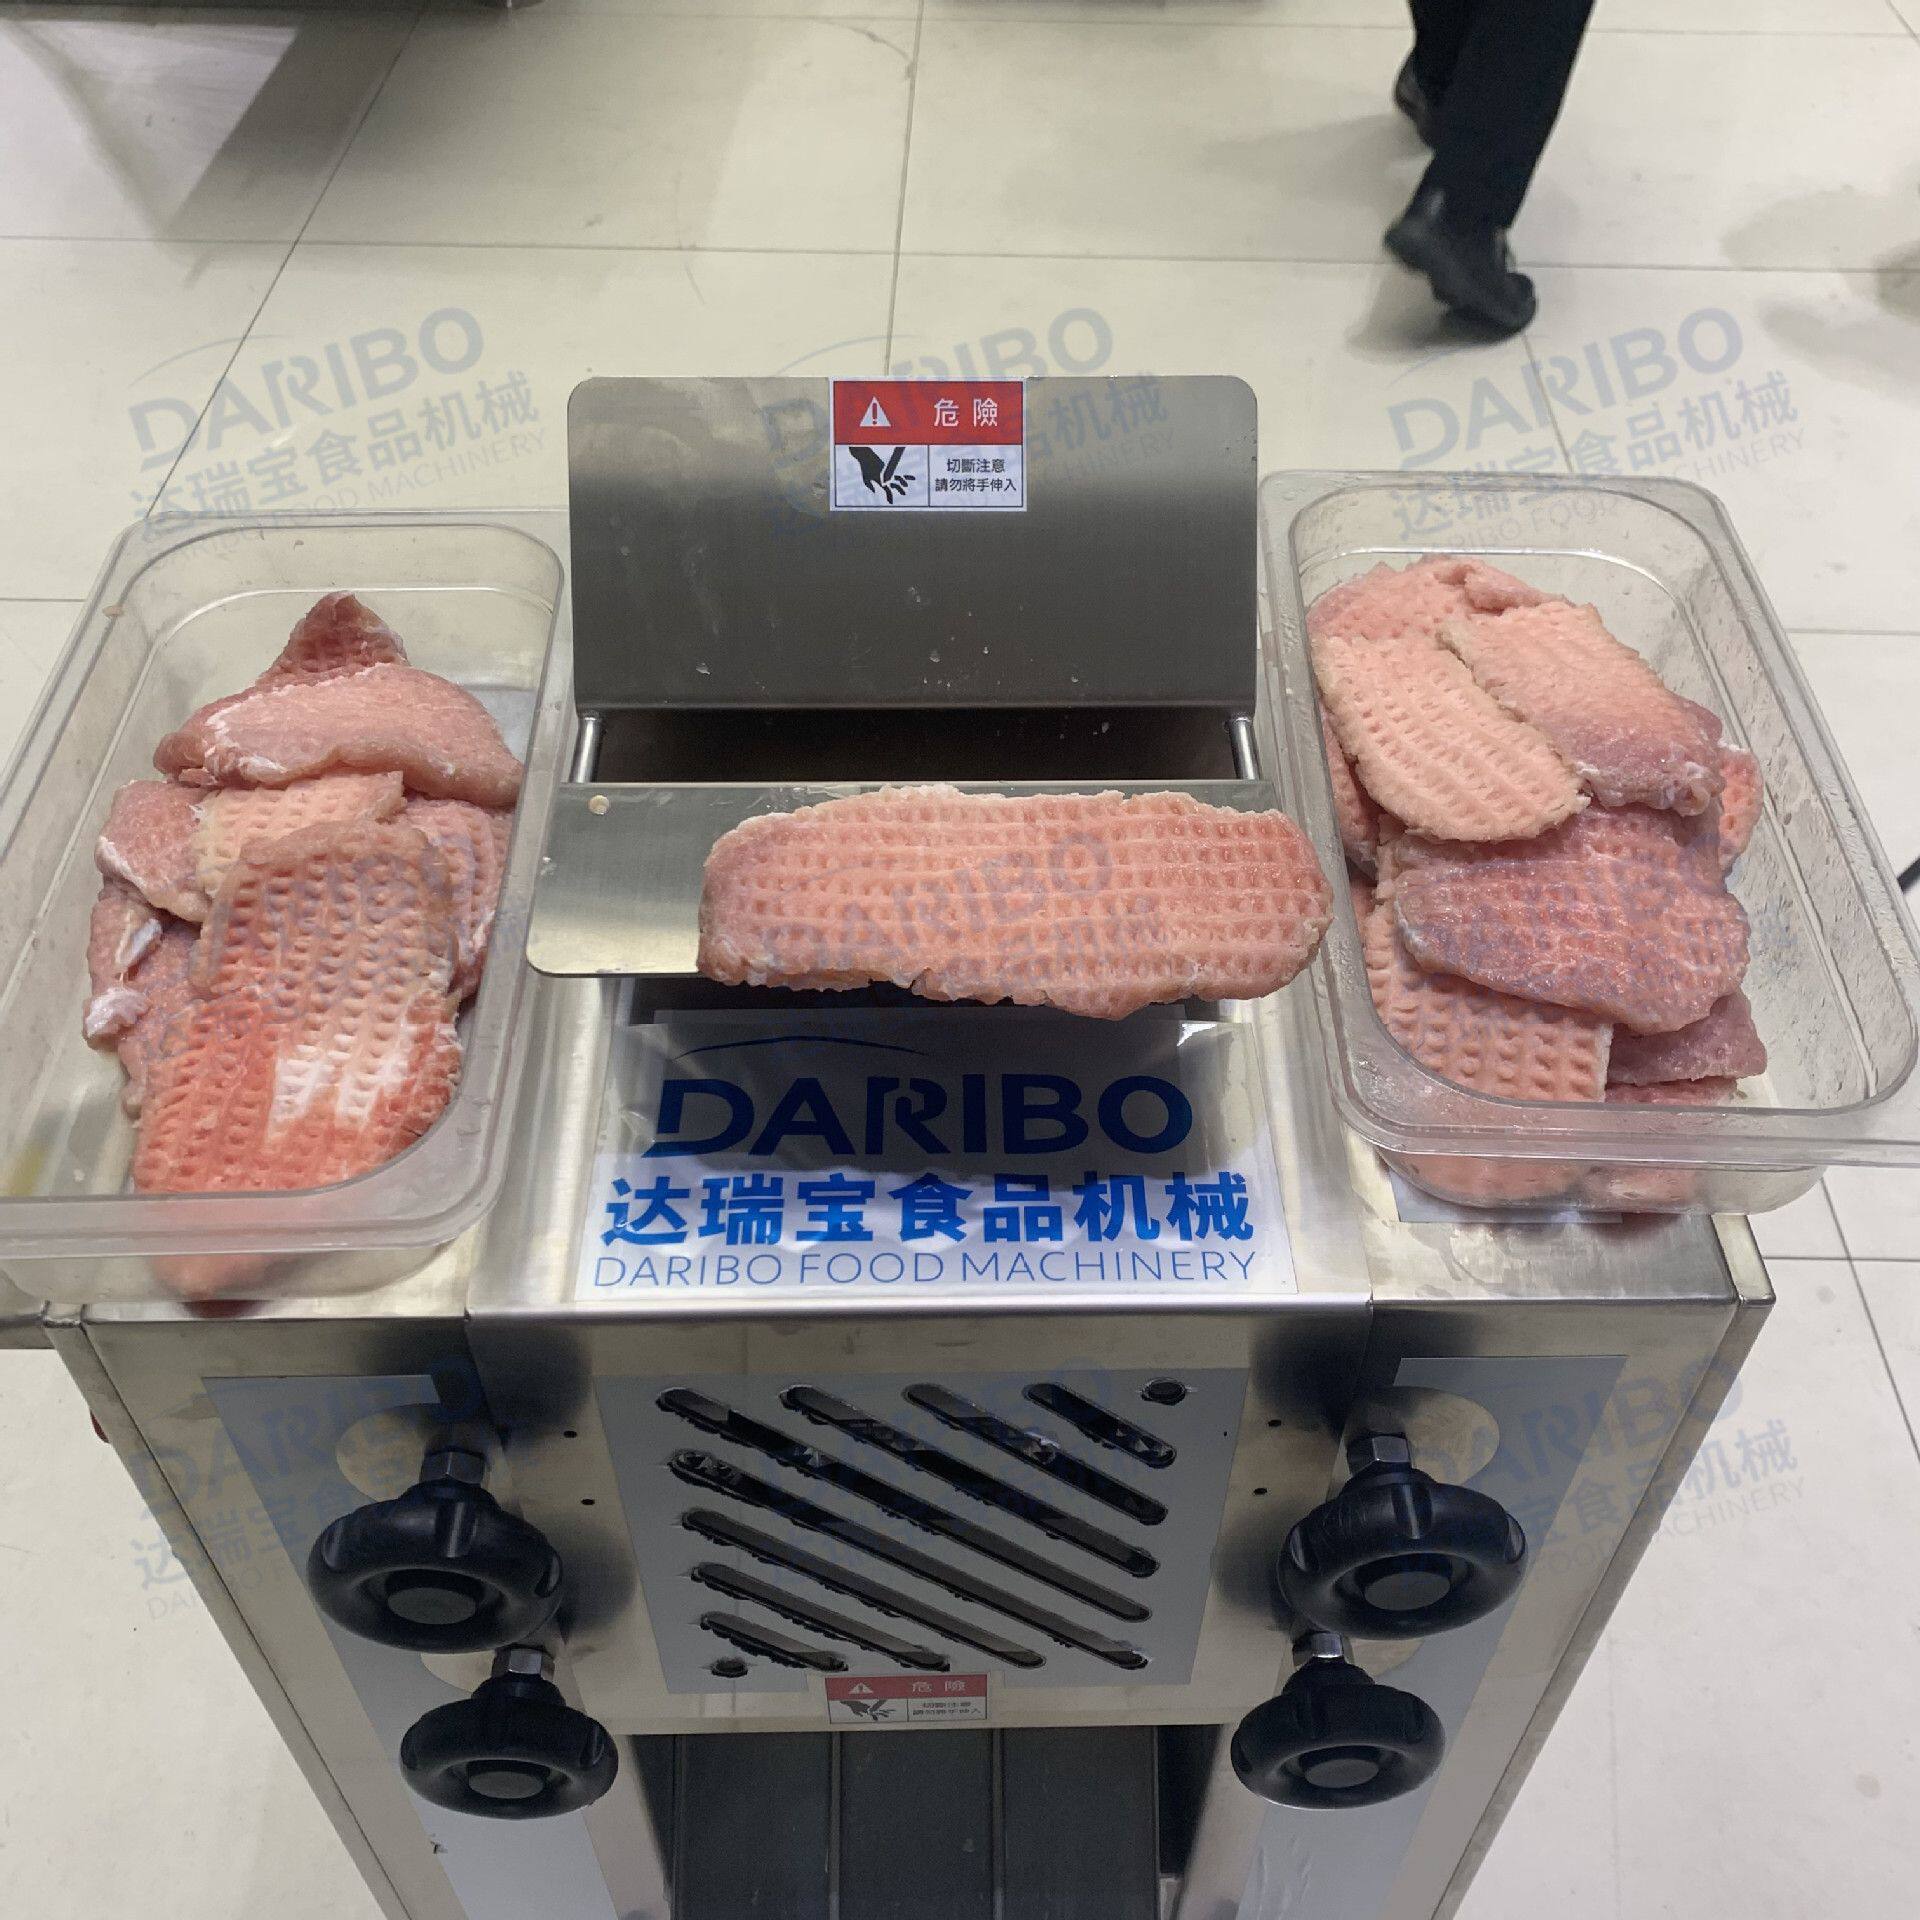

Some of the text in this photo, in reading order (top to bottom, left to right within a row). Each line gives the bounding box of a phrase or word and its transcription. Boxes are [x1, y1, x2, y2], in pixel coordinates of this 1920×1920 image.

[934, 398, 998, 427] 危險
[947, 458, 1005, 473] 切斷注意
[935, 478, 1017, 492] 請勿將手伸入
[641, 1074, 1192, 1158] DARIBO
[603, 1172, 1254, 1246] 达瑞宝食品机械
[594, 1250, 1256, 1287] DARIBO FOOD MACHINERY
